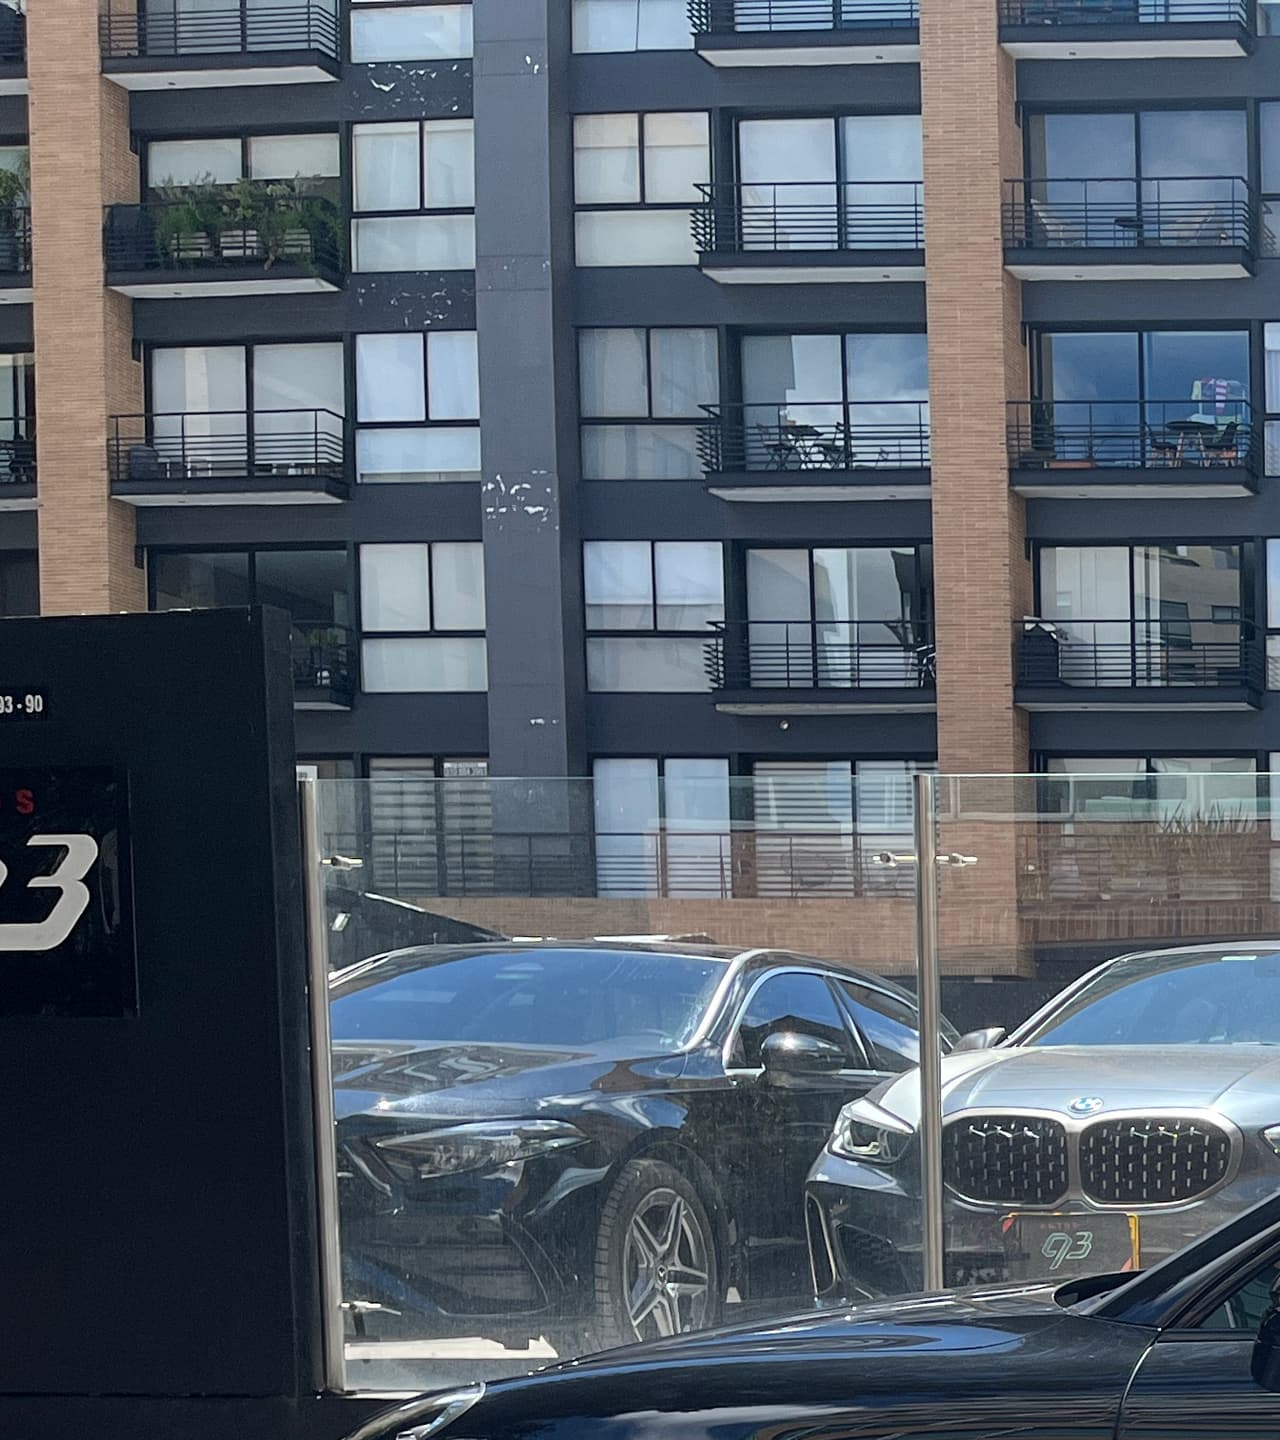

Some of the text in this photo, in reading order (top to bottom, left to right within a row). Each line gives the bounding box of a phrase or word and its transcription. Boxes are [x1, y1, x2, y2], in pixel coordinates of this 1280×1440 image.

[25, 694, 43, 713] 90
[0, 833, 99, 951] 3
[1041, 1231, 1093, 1270] 93
